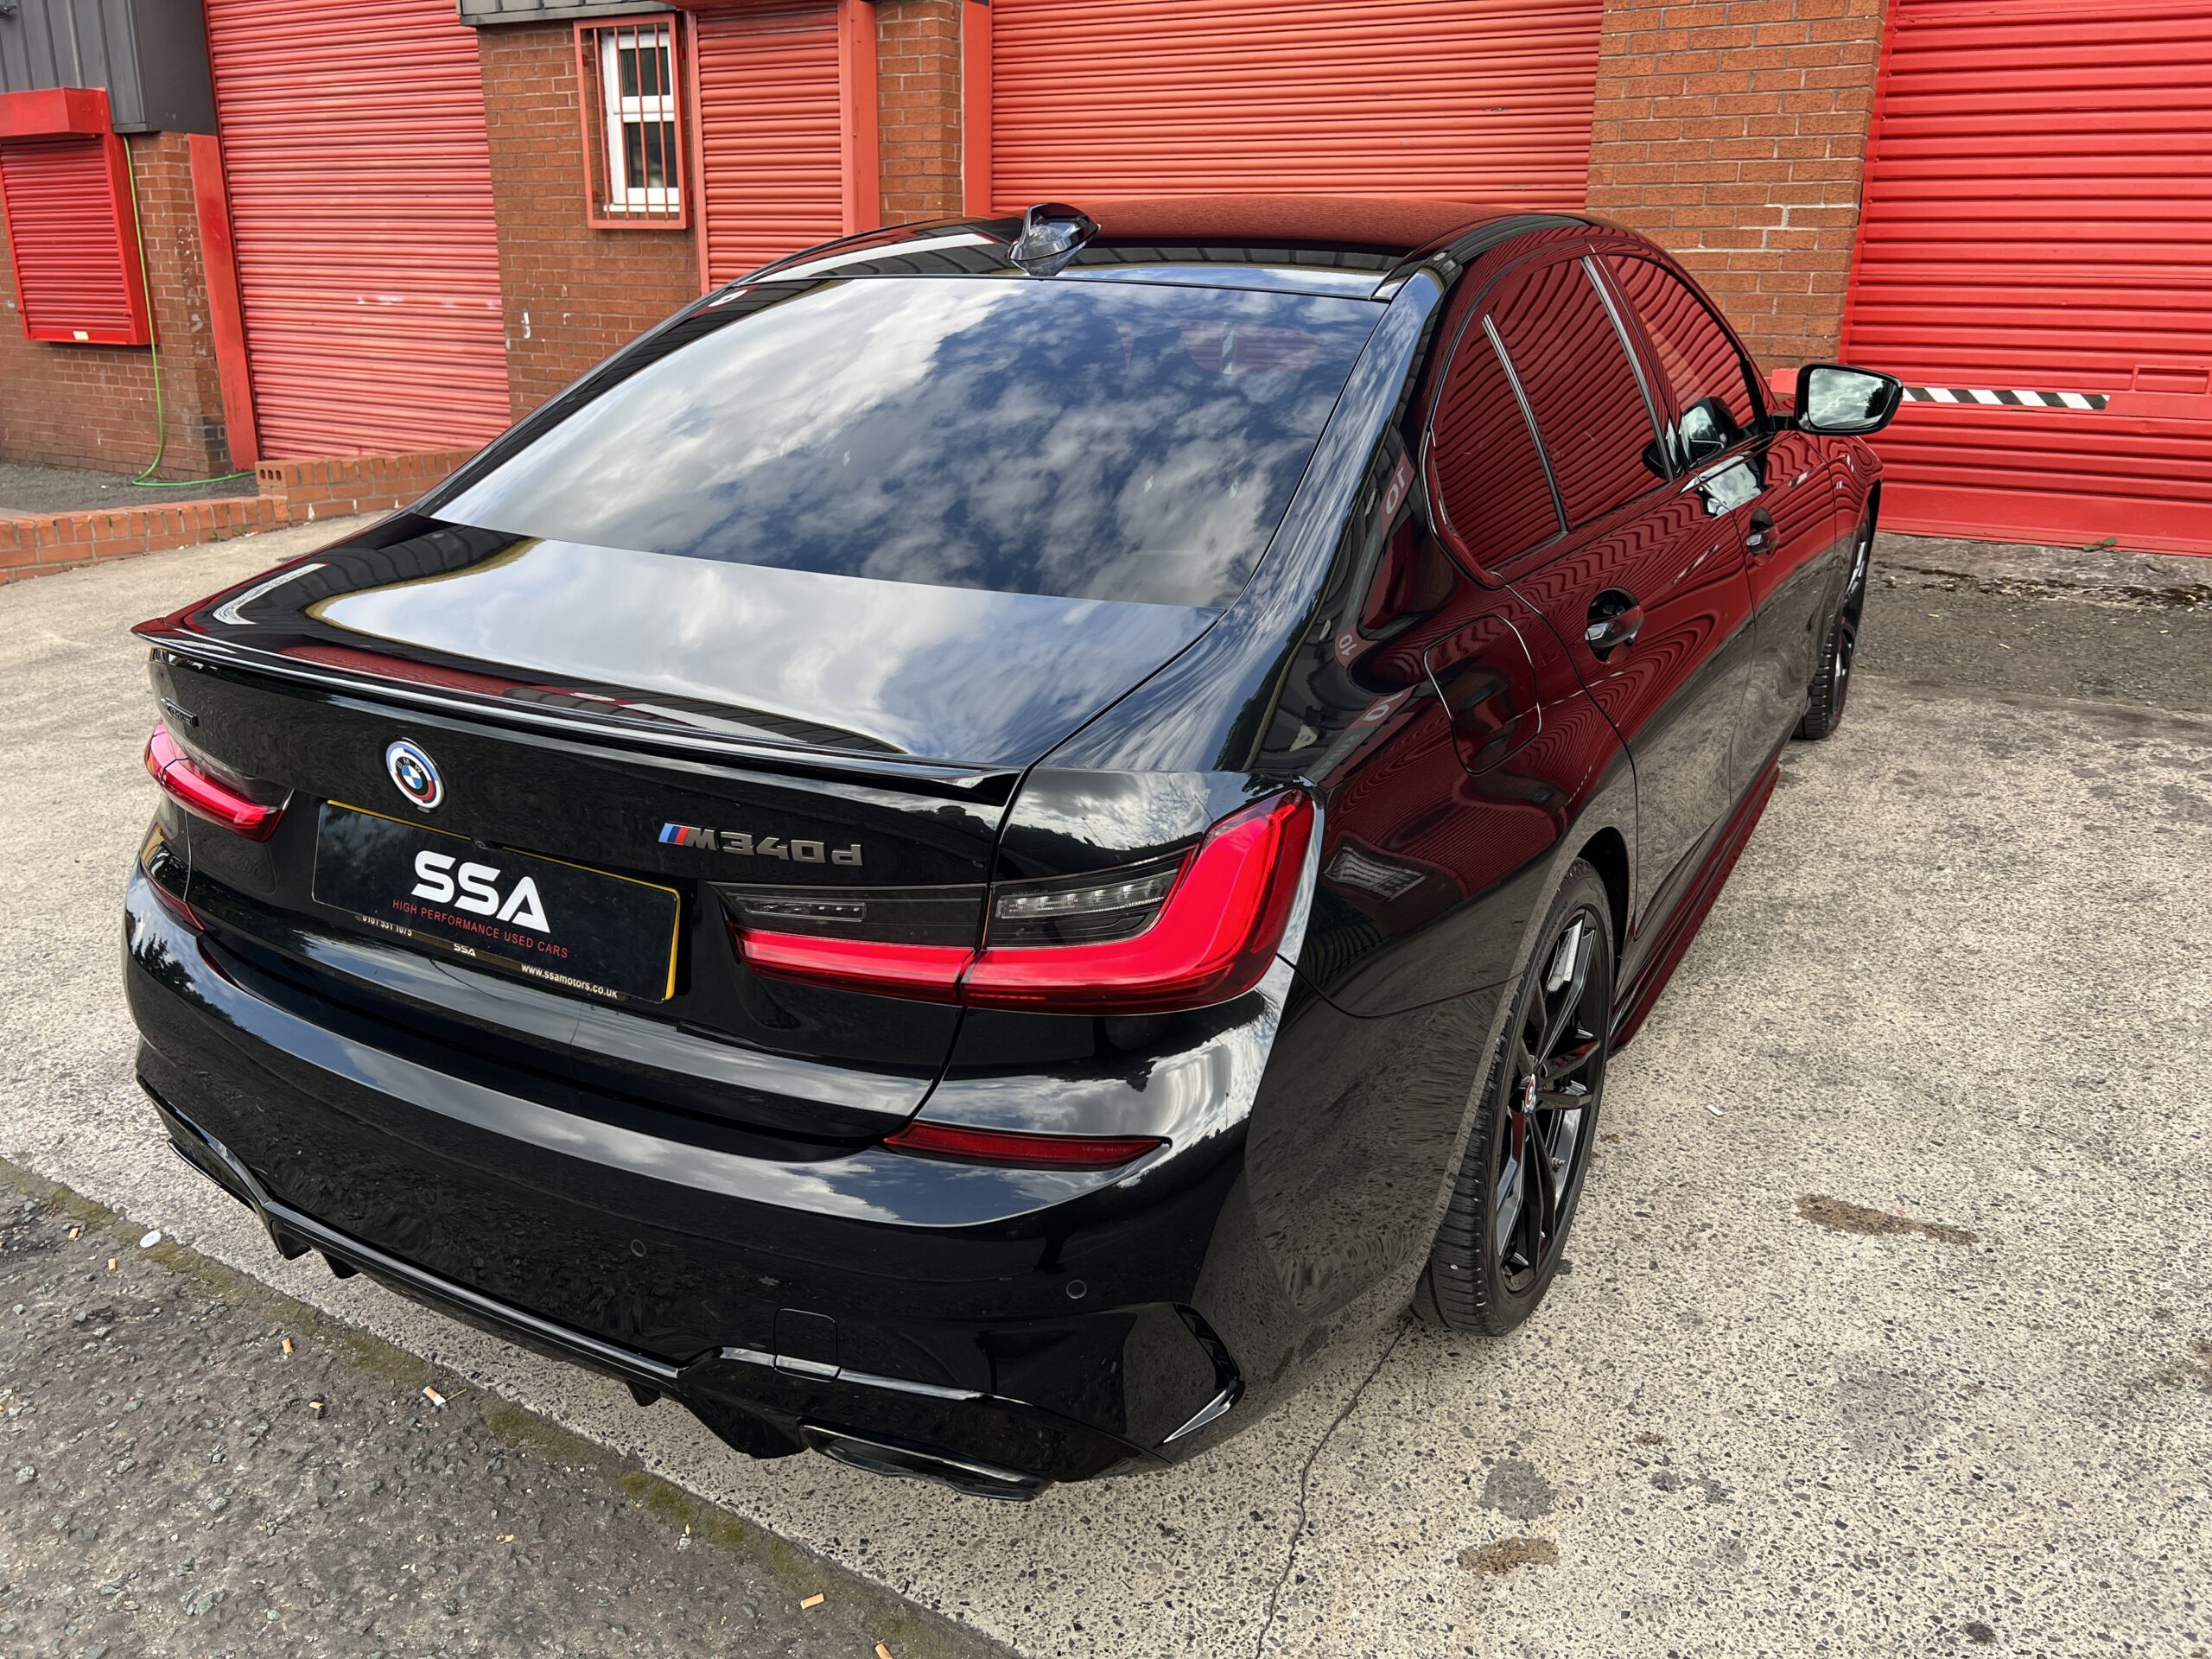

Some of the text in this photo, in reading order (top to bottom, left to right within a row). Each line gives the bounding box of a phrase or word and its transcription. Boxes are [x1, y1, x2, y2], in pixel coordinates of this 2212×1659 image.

[396, 757, 423, 773] BMW
[681, 825, 863, 867] M340d
[410, 850, 550, 933] SSA
[392, 899, 568, 959] HIGH PERFORMANCE USED CARS
[454, 943, 476, 957] SSA
[521, 963, 618, 999] www.ssamotors.co.uk
